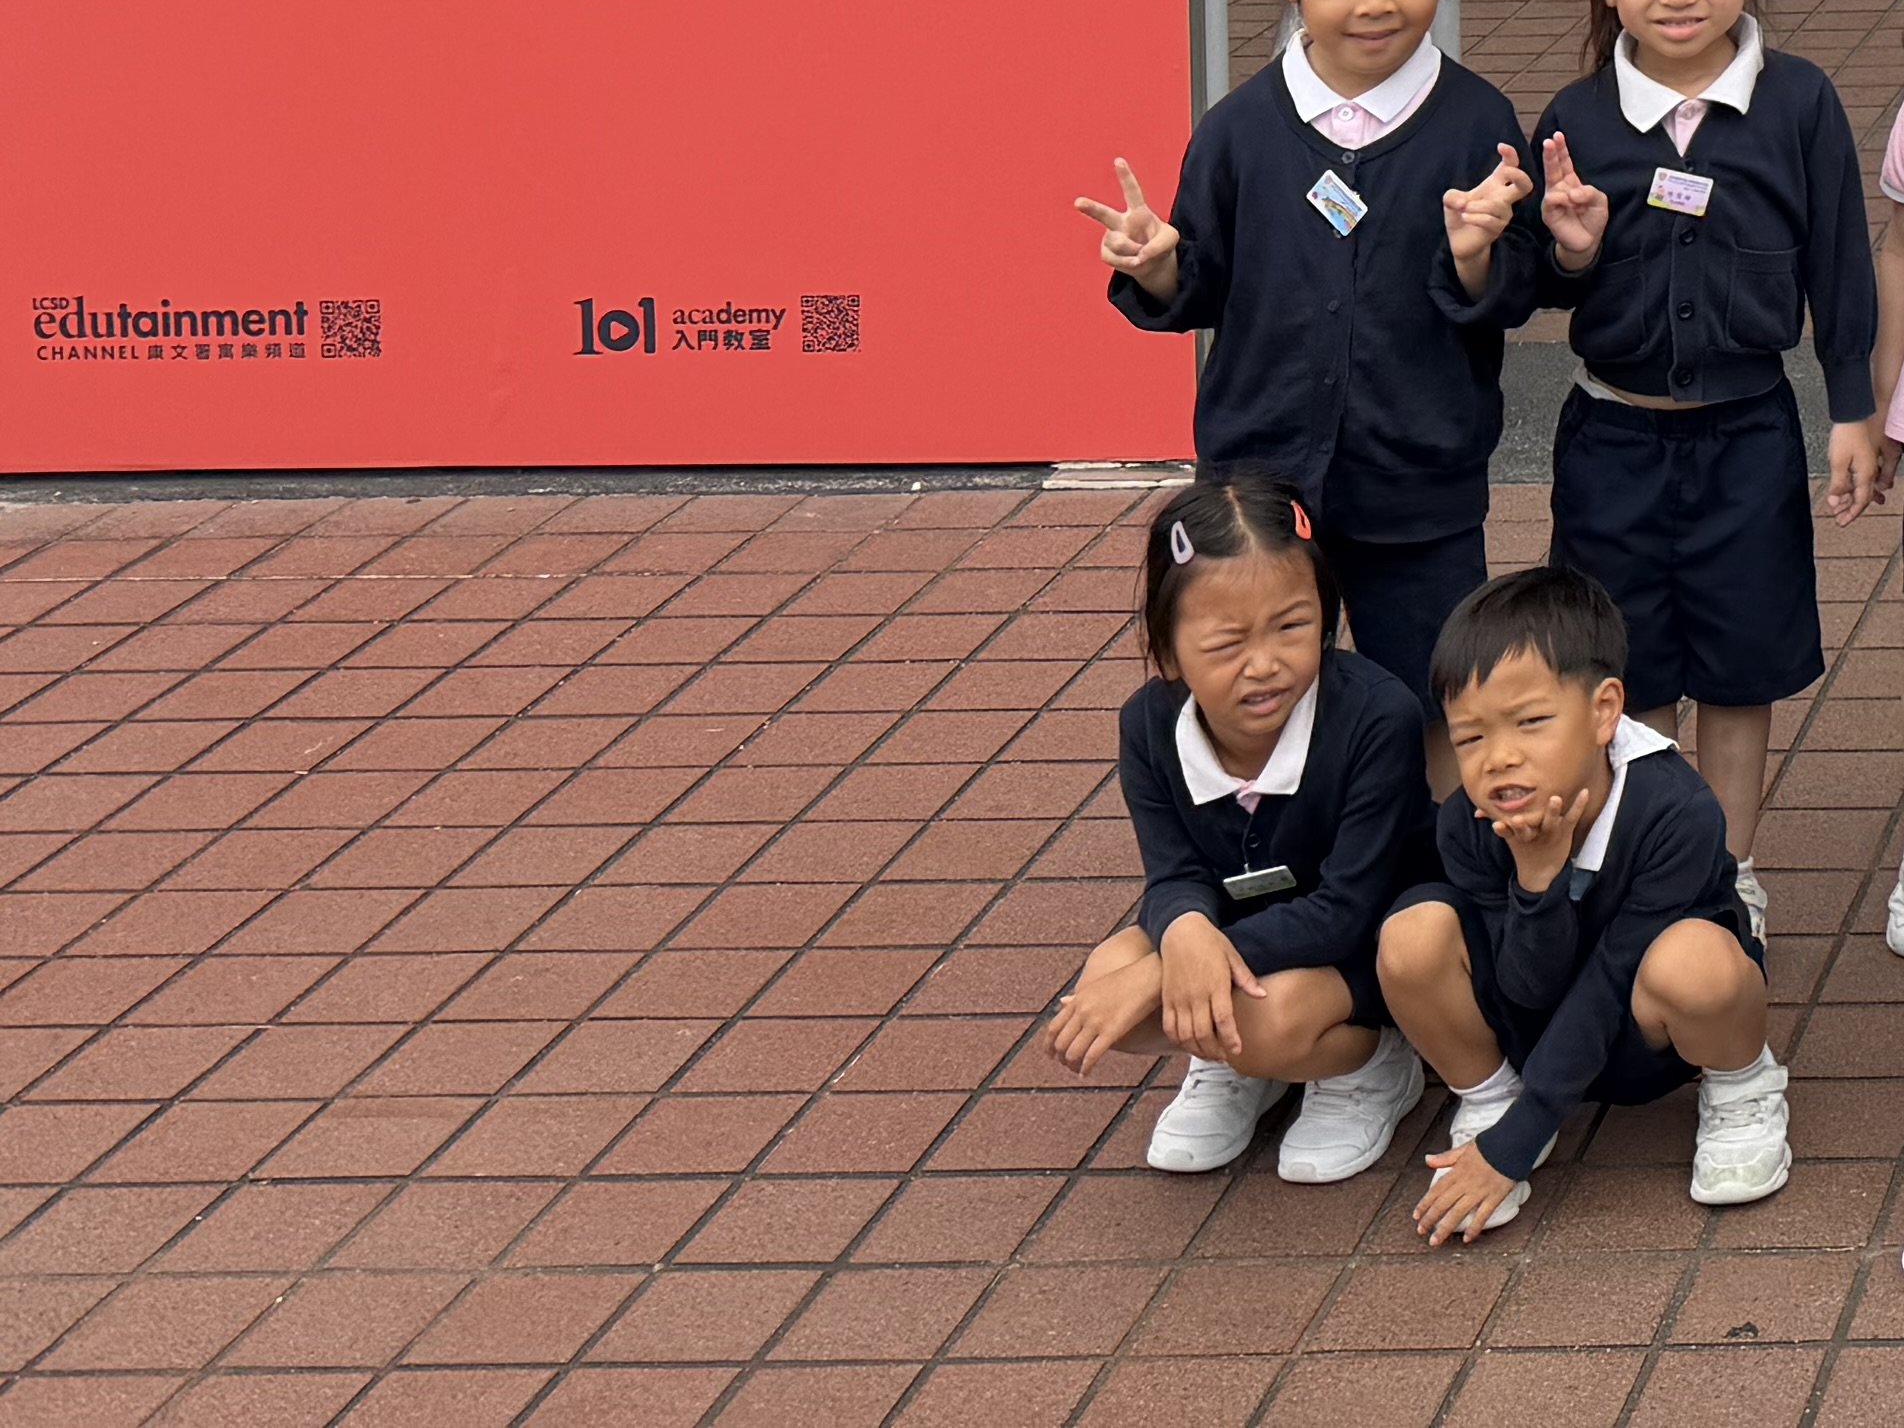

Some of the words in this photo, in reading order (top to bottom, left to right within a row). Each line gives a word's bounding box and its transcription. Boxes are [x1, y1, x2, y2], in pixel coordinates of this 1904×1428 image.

[32, 296, 70, 311] LCSD
[32, 295, 309, 340] edutainment
[672, 301, 786, 331] academy
[671, 328, 772, 351] 入門教室
[36, 345, 140, 361] CHANNEL
